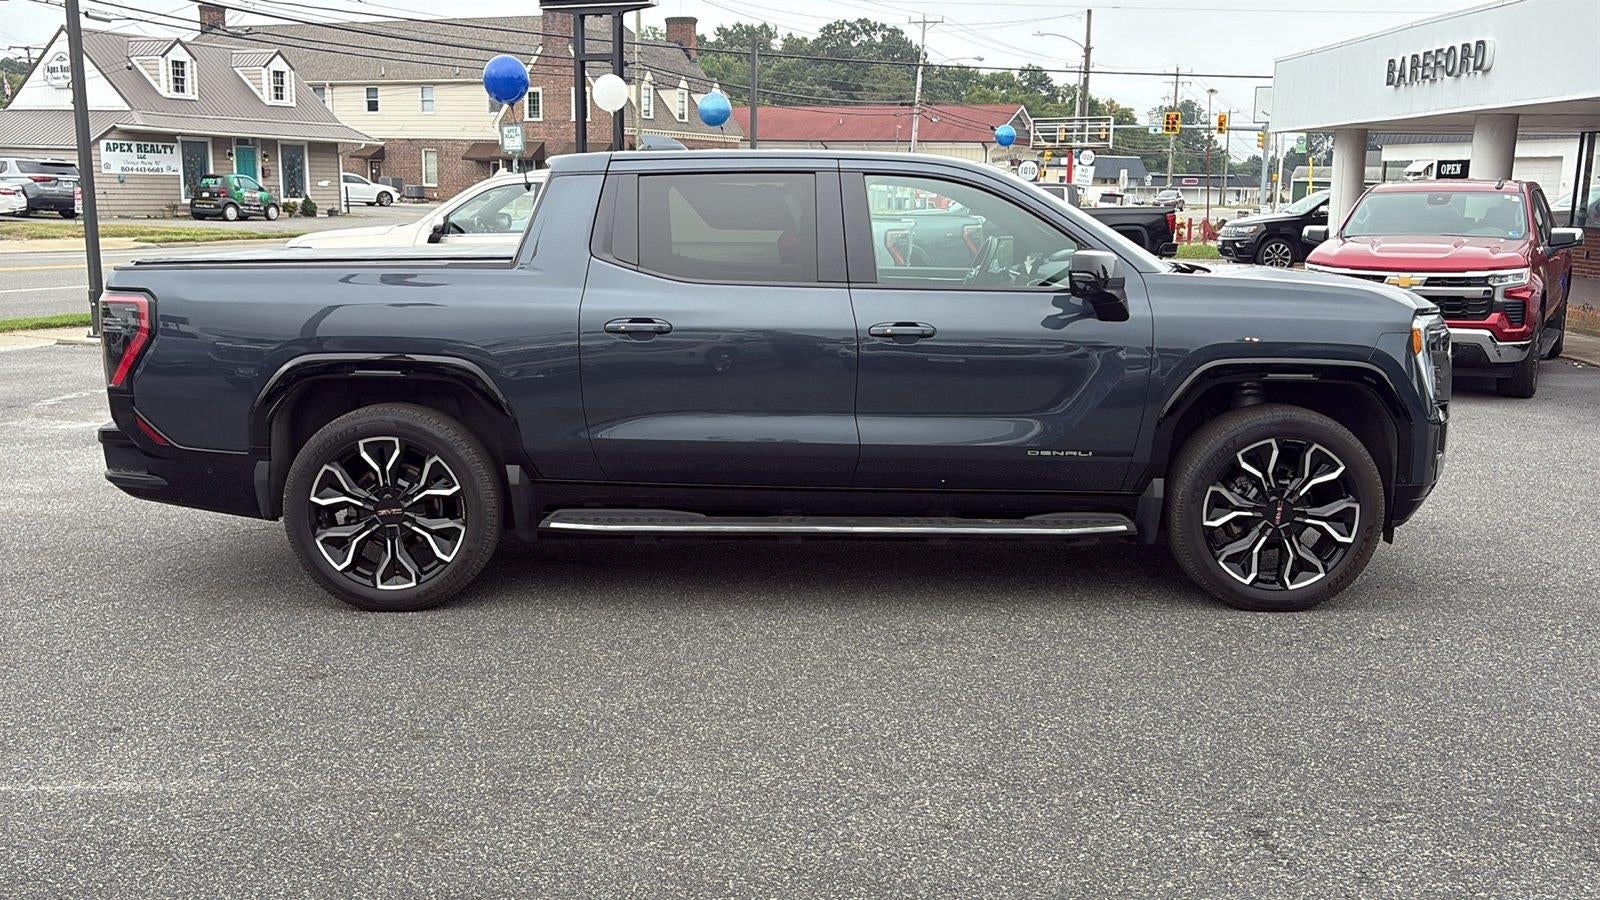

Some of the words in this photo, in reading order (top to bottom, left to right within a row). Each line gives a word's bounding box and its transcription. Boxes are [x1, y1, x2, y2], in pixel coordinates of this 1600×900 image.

[1386, 40, 1494, 87] BAREFORD
[105, 142, 133, 153] APEX
[136, 143, 175, 154] REALTY
[1020, 166, 1036, 175] 1010
[1441, 163, 1462, 175] OPEN
